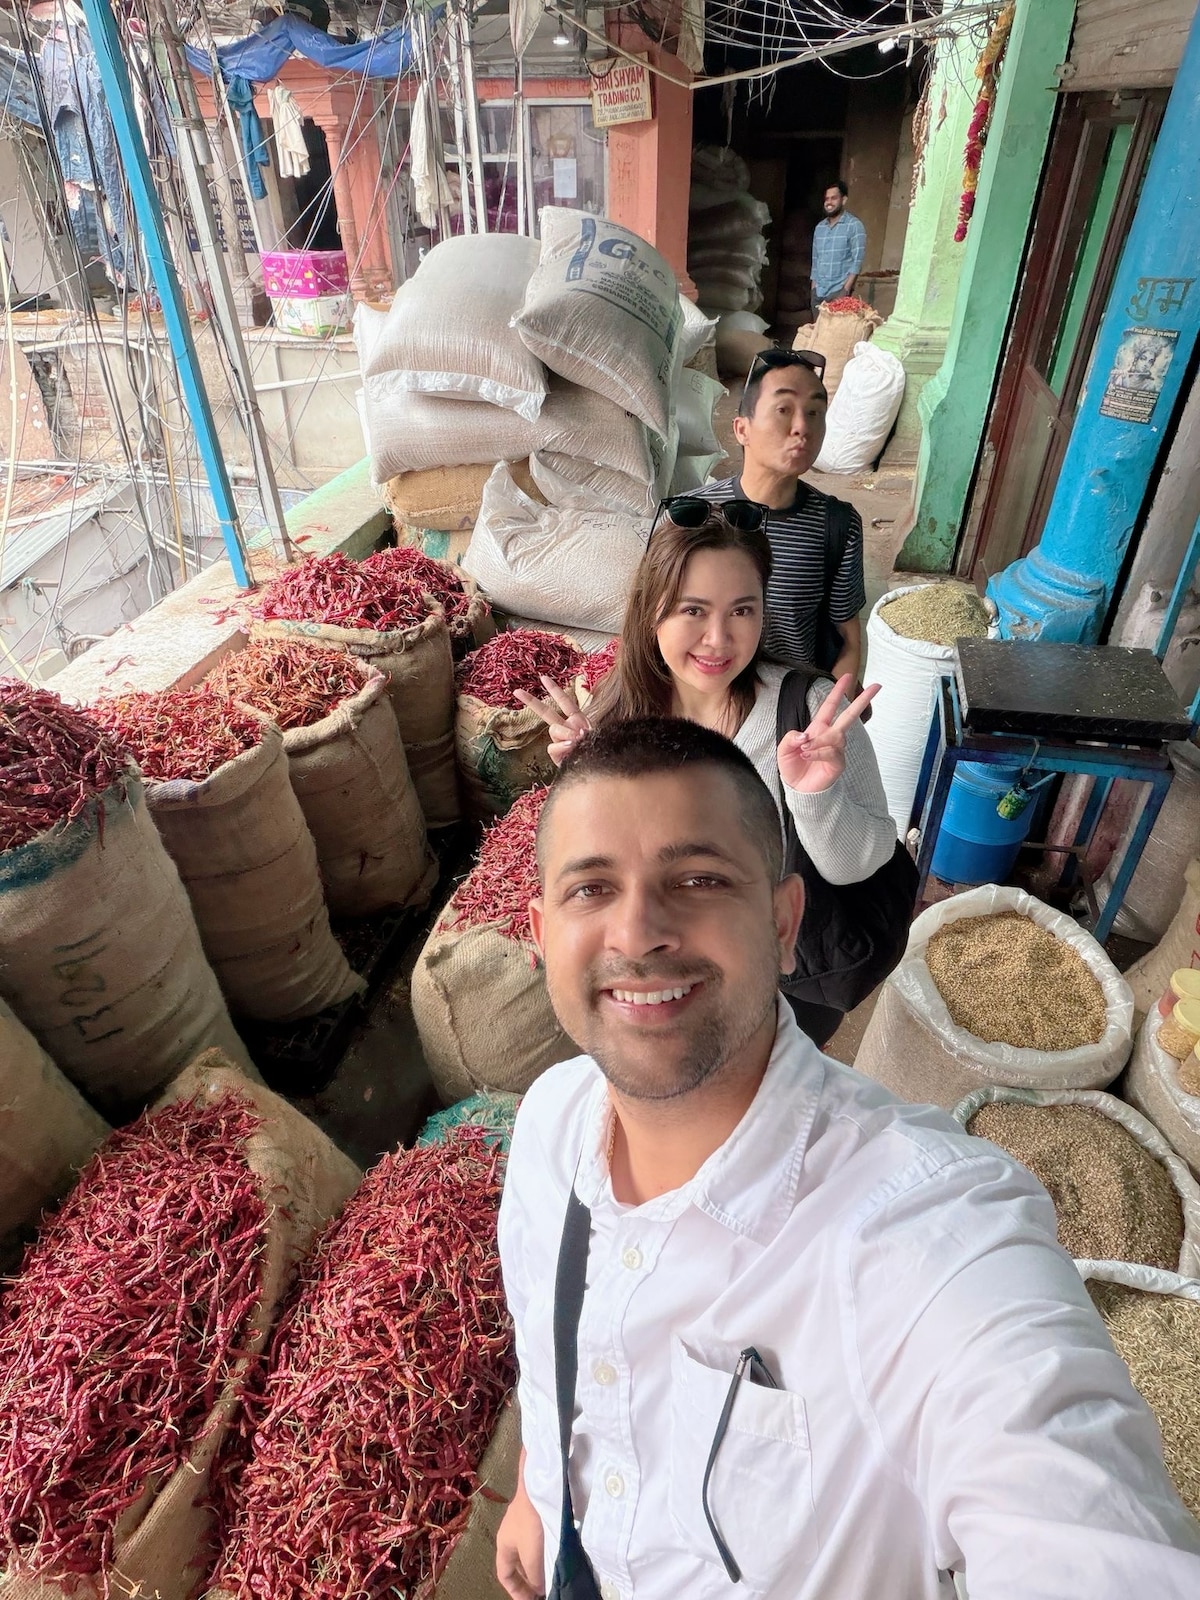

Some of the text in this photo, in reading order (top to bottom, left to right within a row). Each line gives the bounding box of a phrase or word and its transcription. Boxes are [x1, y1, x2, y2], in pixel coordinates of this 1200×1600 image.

[592, 70, 613, 91] SHRI
[614, 65, 645, 88] SHYAM
[598, 87, 643, 107] TRADING CO.
[592, 283, 637, 308] CORIANDER
[638, 306, 659, 329] SEEDS
